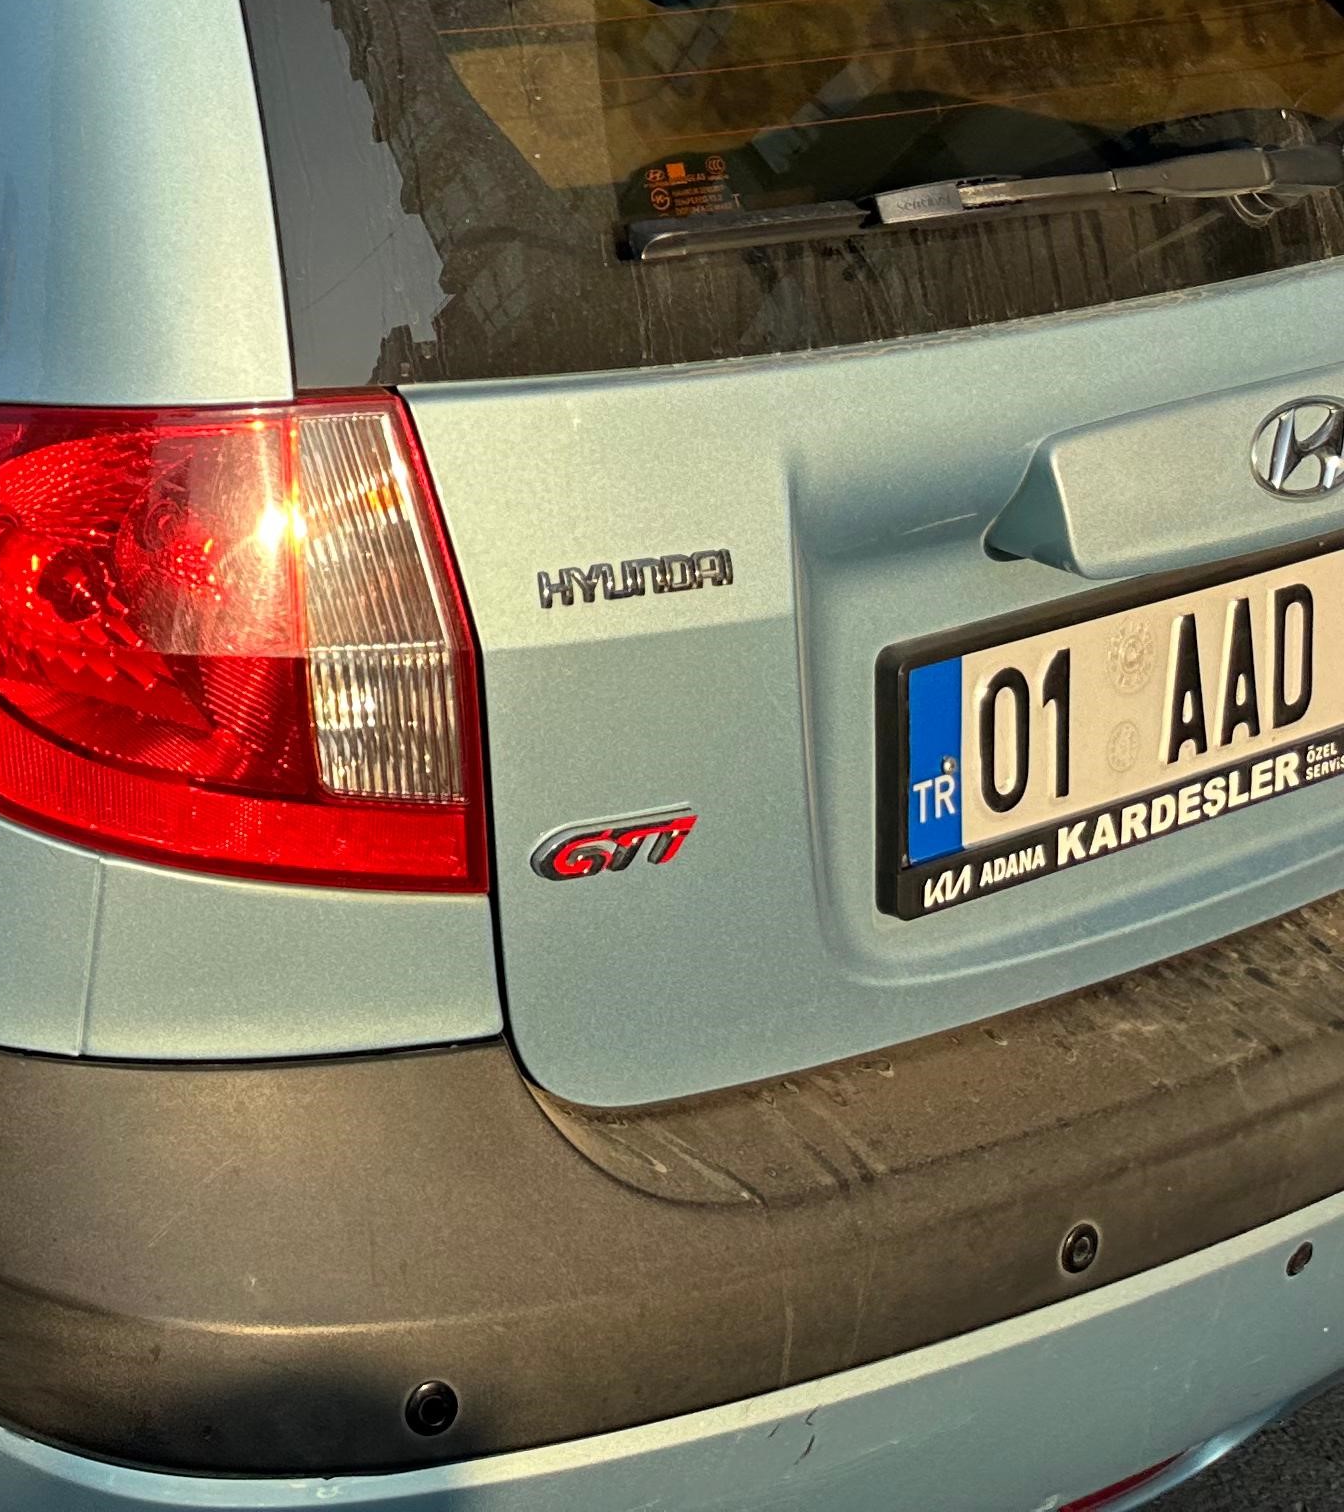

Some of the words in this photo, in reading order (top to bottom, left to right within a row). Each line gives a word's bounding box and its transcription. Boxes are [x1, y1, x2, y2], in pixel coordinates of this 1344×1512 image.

[537, 548, 734, 609] HYUNDAI
[978, 648, 1071, 814] 01
[1162, 583, 1314, 765] AAD
[1305, 741, 1339, 764] ÖZEL
[912, 774, 957, 824] TR
[979, 844, 1047, 888] ADANA
[1056, 751, 1300, 866] KARDEŞLER
